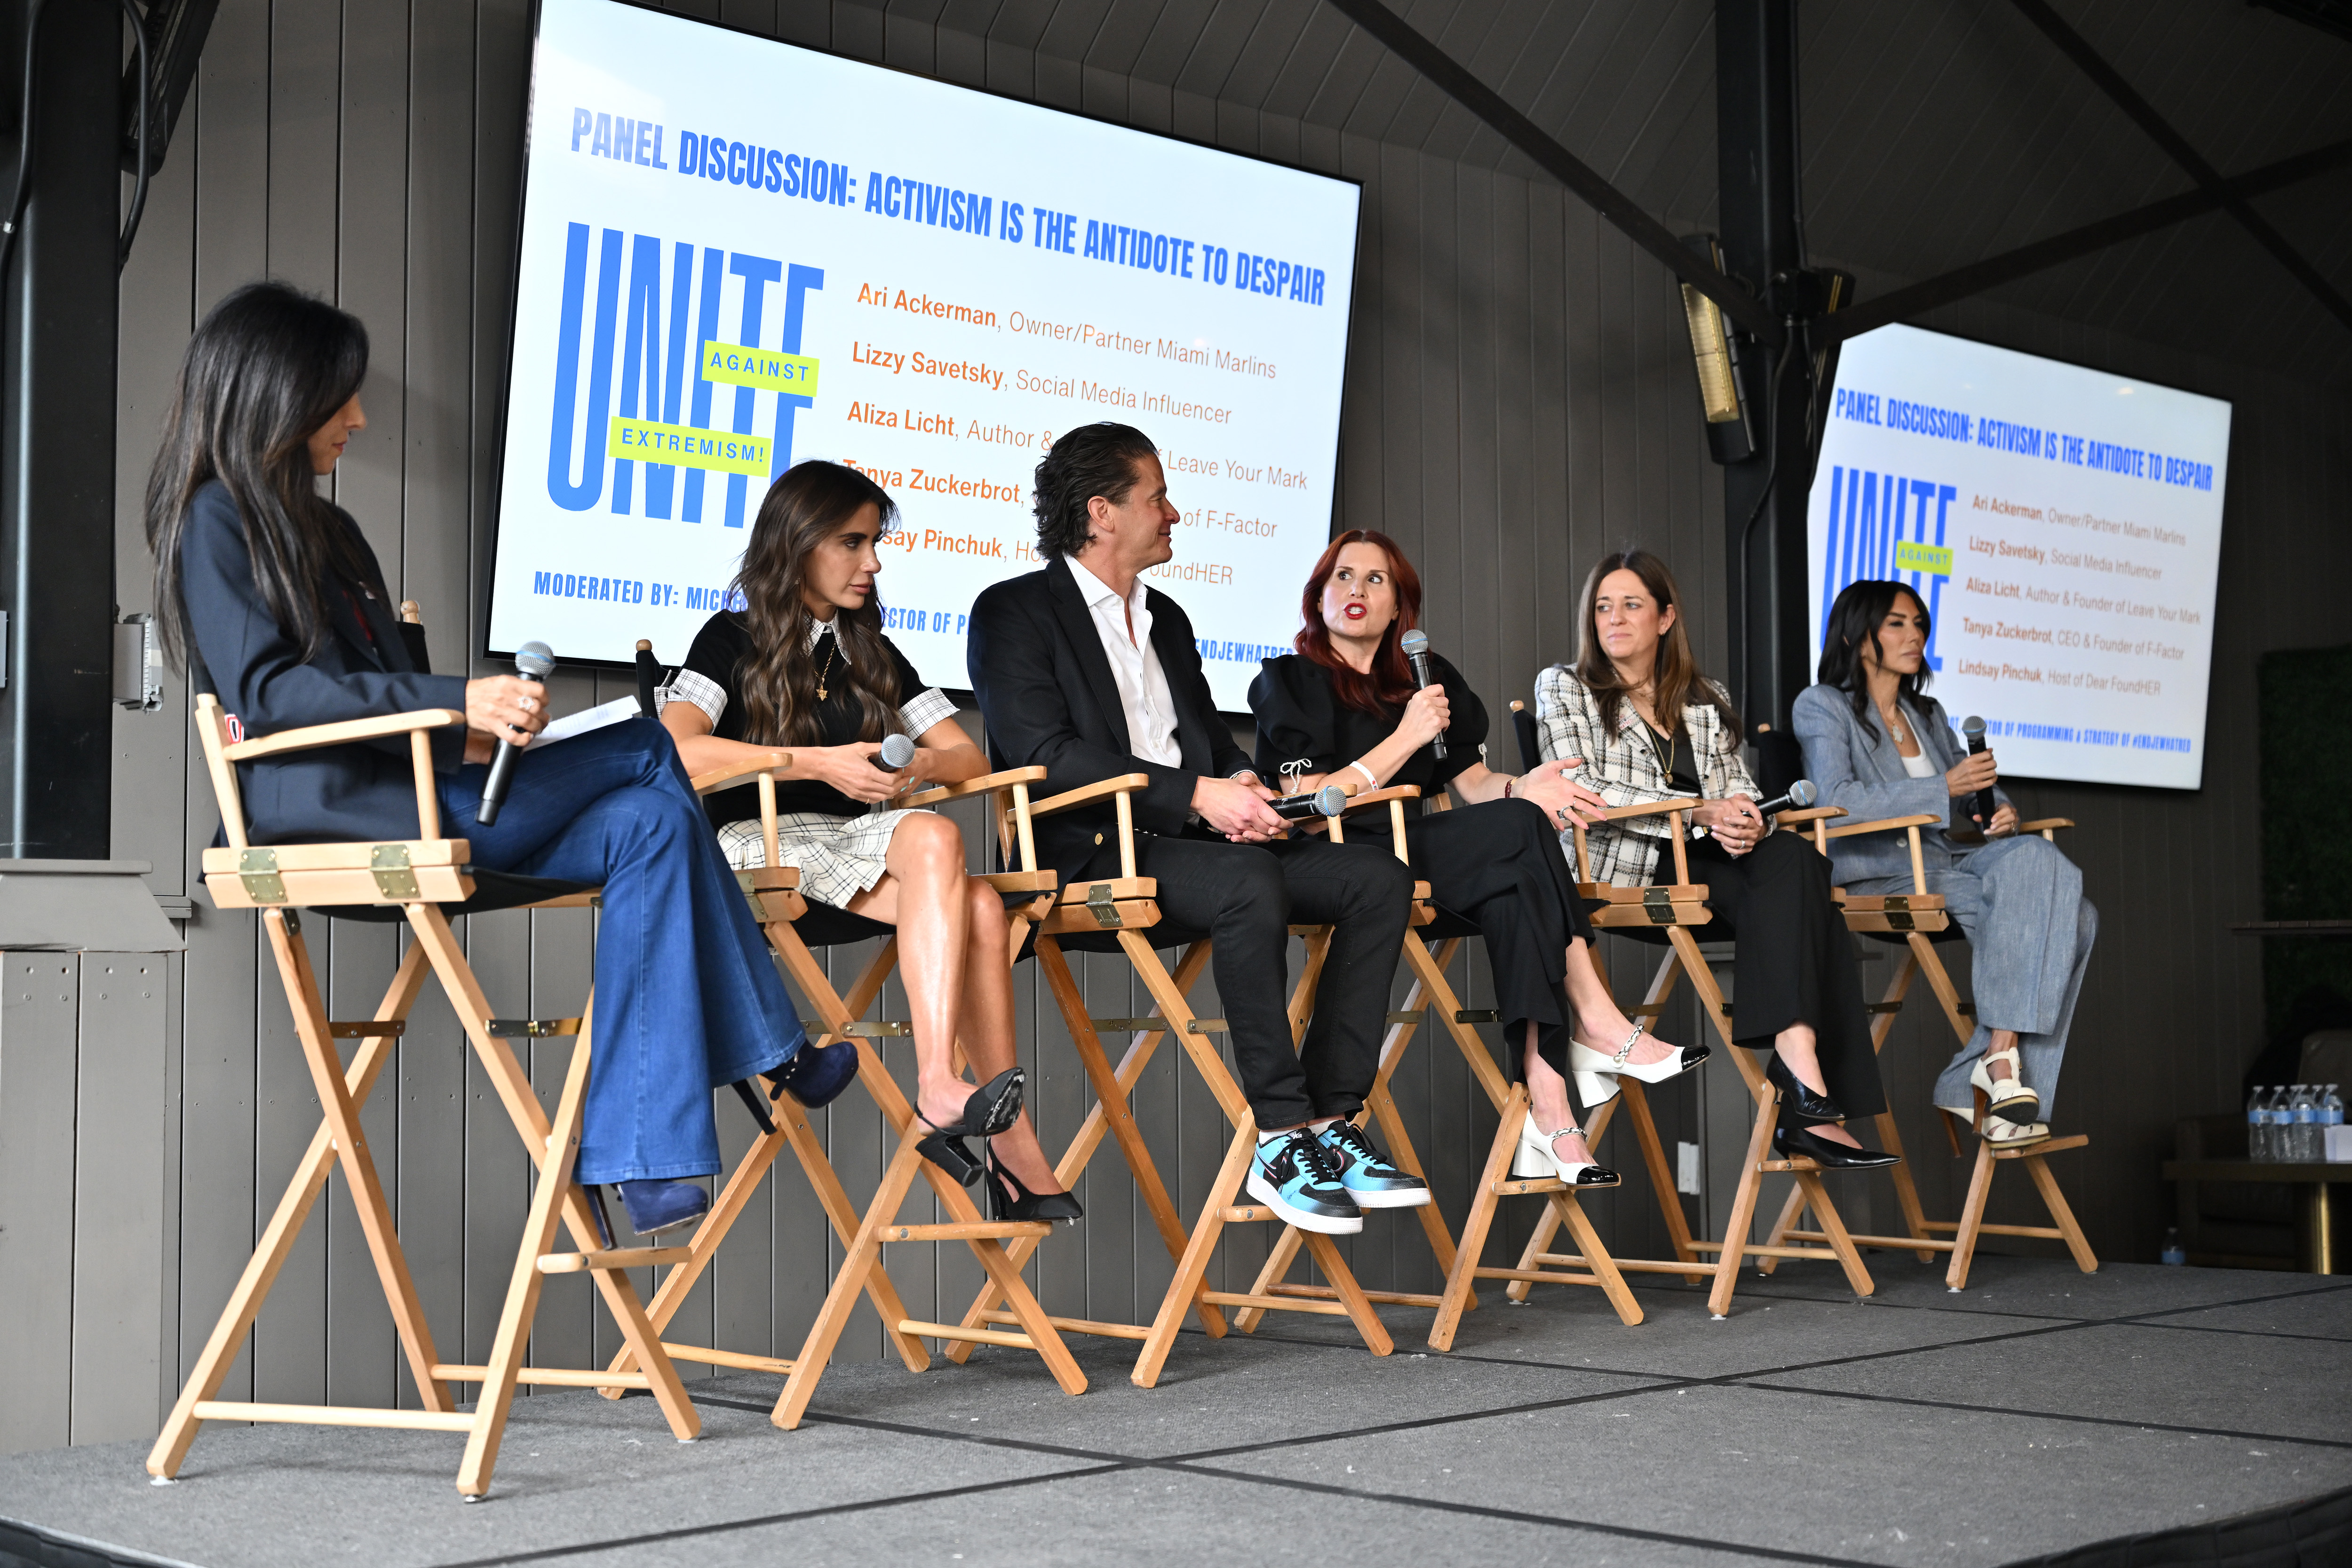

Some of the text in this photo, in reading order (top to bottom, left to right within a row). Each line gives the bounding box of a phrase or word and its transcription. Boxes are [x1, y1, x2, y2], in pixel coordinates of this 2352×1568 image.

[572, 107, 1325, 306] PANEL DISCUSSION: ACTIVISM IS THE ANTIDOTE TO DESPAIR
[858, 283, 1277, 379] Ari Ackerman, Owner/Partner Miami Marlins
[710, 352, 809, 382] AGAINST
[853, 342, 1232, 424] Lizzy Savetsky, Social Media Influencer
[622, 429, 764, 462] EXTREMISM!
[847, 401, 898, 428] Aliza
[905, 409, 959, 441] Licht,
[967, 420, 1034, 447] Author
[1041, 430, 1053, 451] &
[1168, 450, 1218, 476] Leave
[1225, 459, 1263, 483] Your
[1268, 466, 1308, 490] Mark
[1836, 388, 2213, 491] PANEL DISCUSSION: ACTIVISM IS THE ANTIDOTE TO DESPAIR
[909, 468, 1024, 508] Zuckerbrot,
[1184, 509, 1202, 526] of
[1207, 510, 1278, 538] F-Factor
[1973, 495, 2186, 546] Ari Ackerman, Owner/Partner Miami Marlins
[924, 529, 1007, 563] Pinchuk,
[1150, 562, 1232, 585] oundHER
[1900, 549, 1947, 564] AGAINST
[1970, 536, 2162, 580] Lizzy Savetsky, Social Media Influencer
[534, 571, 643, 604] MODERATED
[651, 583, 678, 606] BY:
[881, 607, 926, 631] ECTOR
[933, 612, 951, 633] OF
[1966, 577, 2201, 625] Aliza Licht, Author & Founder of Leave Your Mark
[1963, 617, 2185, 660] Tanya Zuckerbrot, CEO & Founder of F-Factor
[1959, 659, 2161, 696] Lindsay Pinchuk, Host of Dear FoundHER
[2005, 721, 2014, 737] OF
[2017, 723, 2074, 743] PROGRAMMING
[2083, 729, 2119, 747] STRATEGY
[2122, 732, 2130, 748] OF
[2132, 734, 2191, 753] #ENDJEWHATRED
